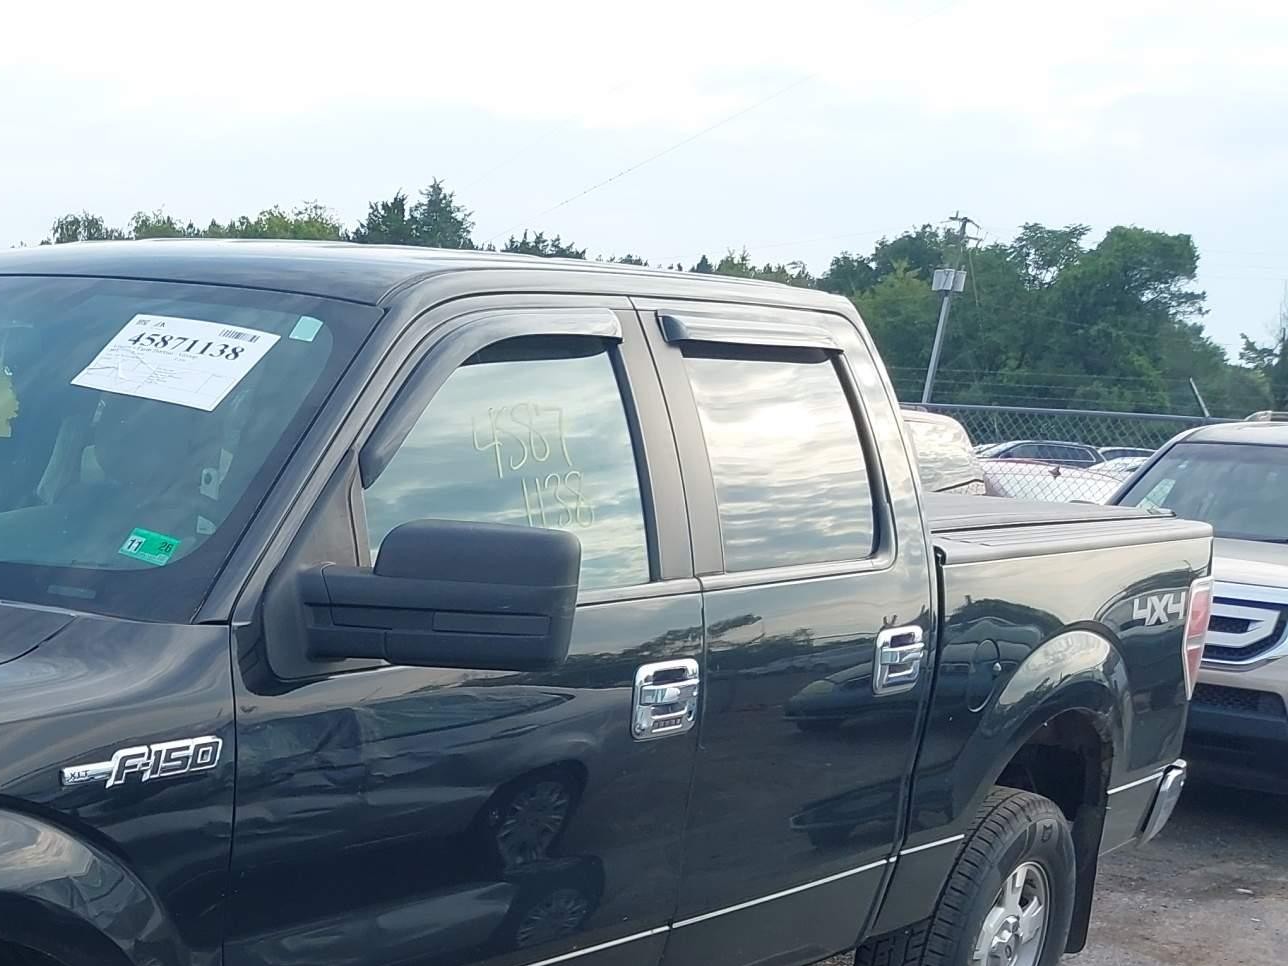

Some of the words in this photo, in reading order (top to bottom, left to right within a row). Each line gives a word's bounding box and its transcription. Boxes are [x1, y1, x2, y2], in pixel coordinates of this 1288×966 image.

[128, 332, 245, 361] 45871138
[472, 401, 573, 479] 4587
[521, 470, 595, 528] 1138
[127, 539, 142, 551] 11
[160, 542, 174, 552] 26
[1132, 591, 1186, 626] 4X4
[105, 735, 223, 788] F-150
